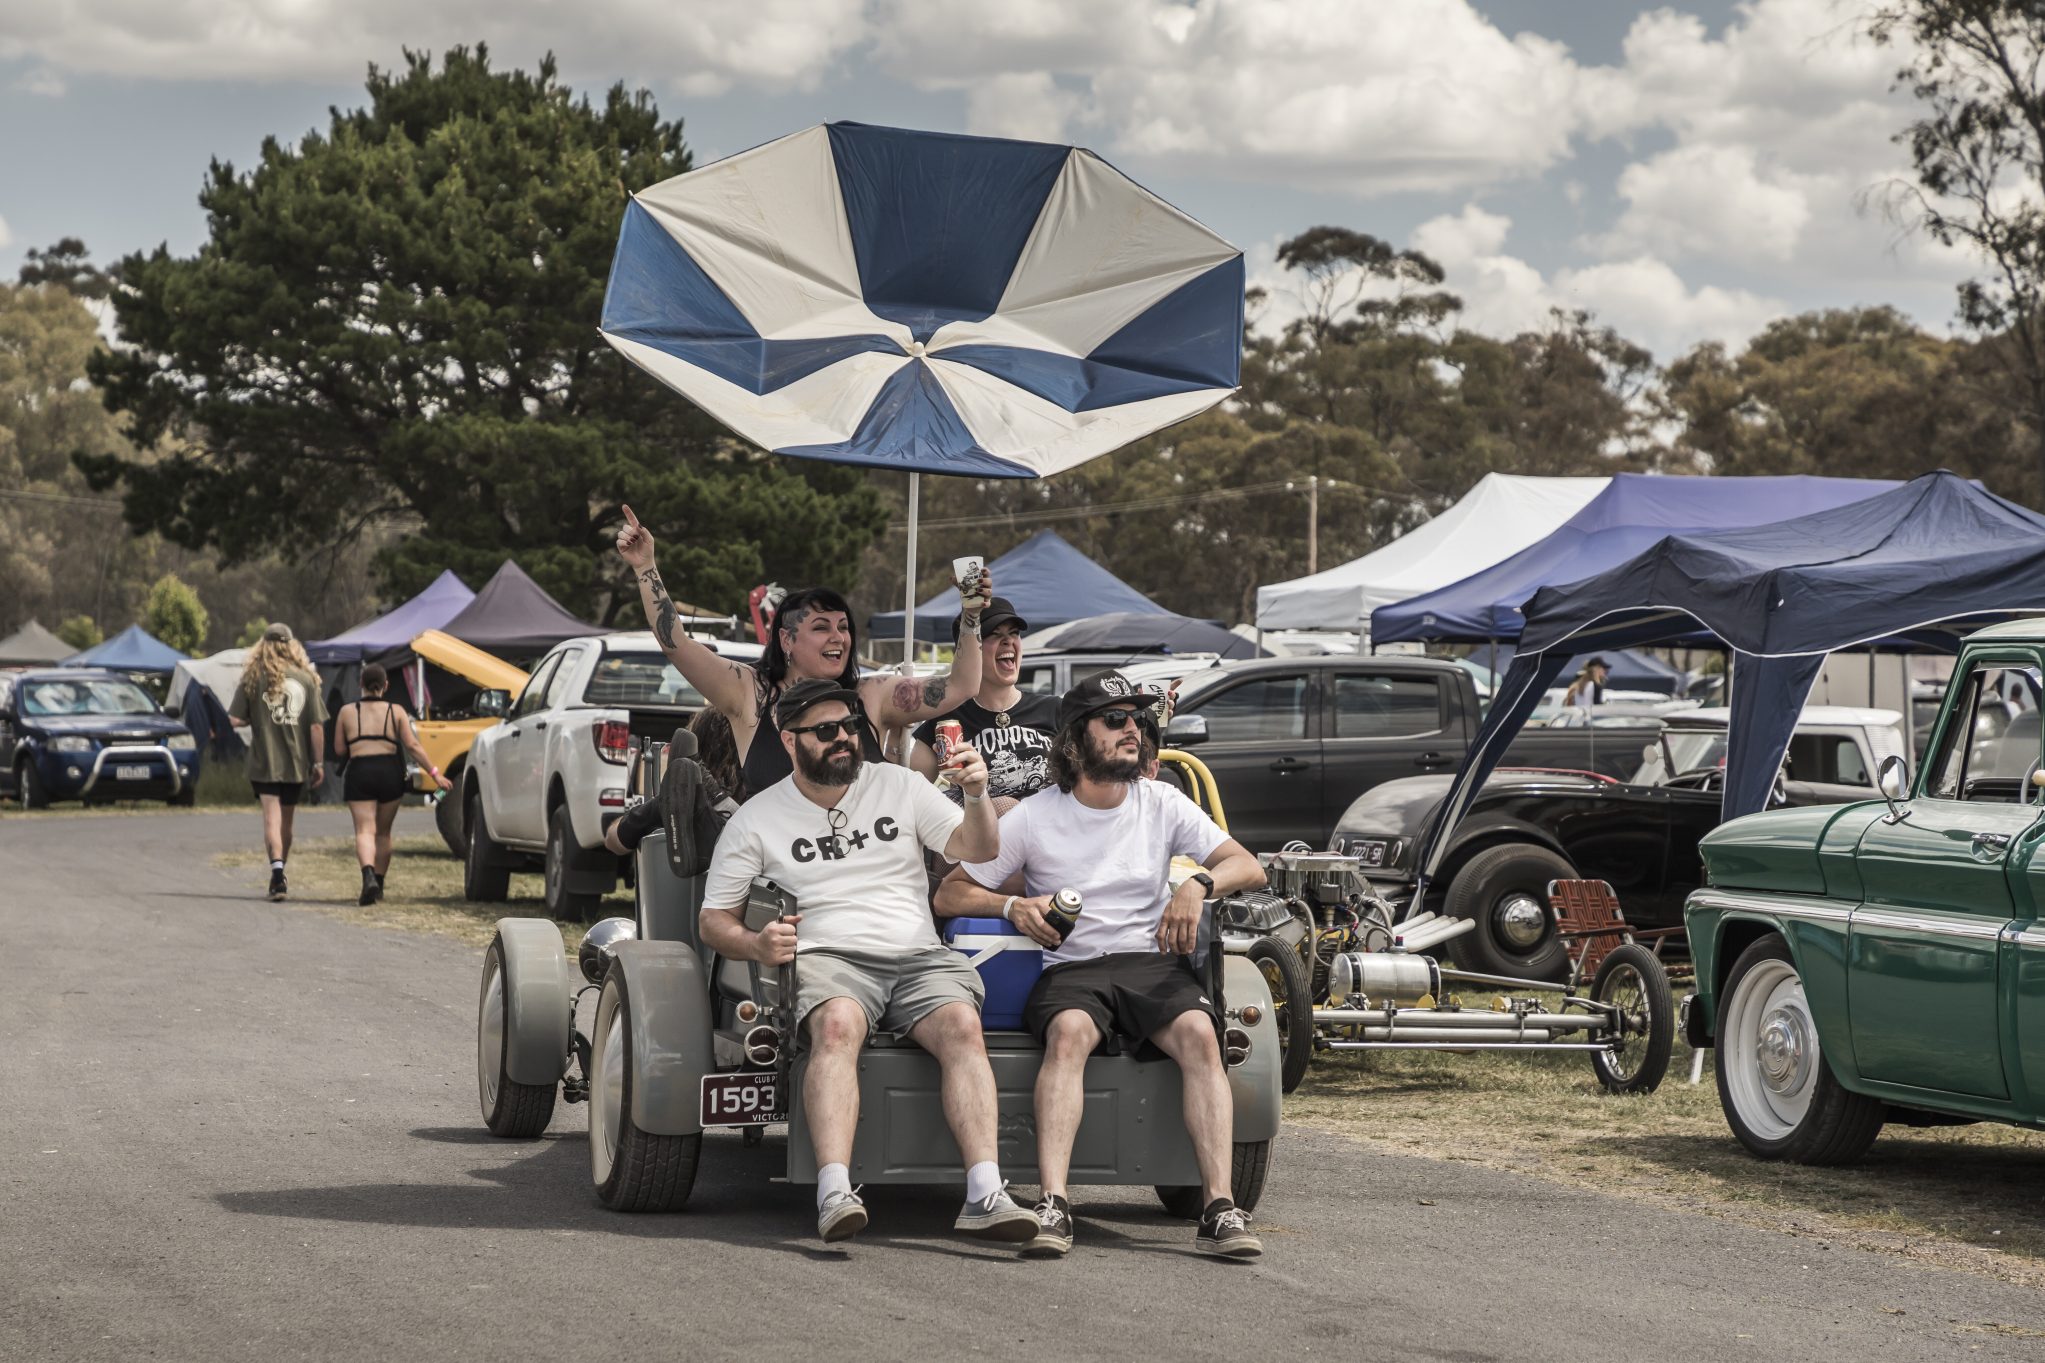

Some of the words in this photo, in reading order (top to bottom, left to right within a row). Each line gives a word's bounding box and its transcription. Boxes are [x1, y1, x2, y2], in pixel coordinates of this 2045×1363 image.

[754, 1075, 771, 1084] CLUB
[709, 1085, 776, 1114] 1593
[752, 1113, 789, 1122] VICTORI
